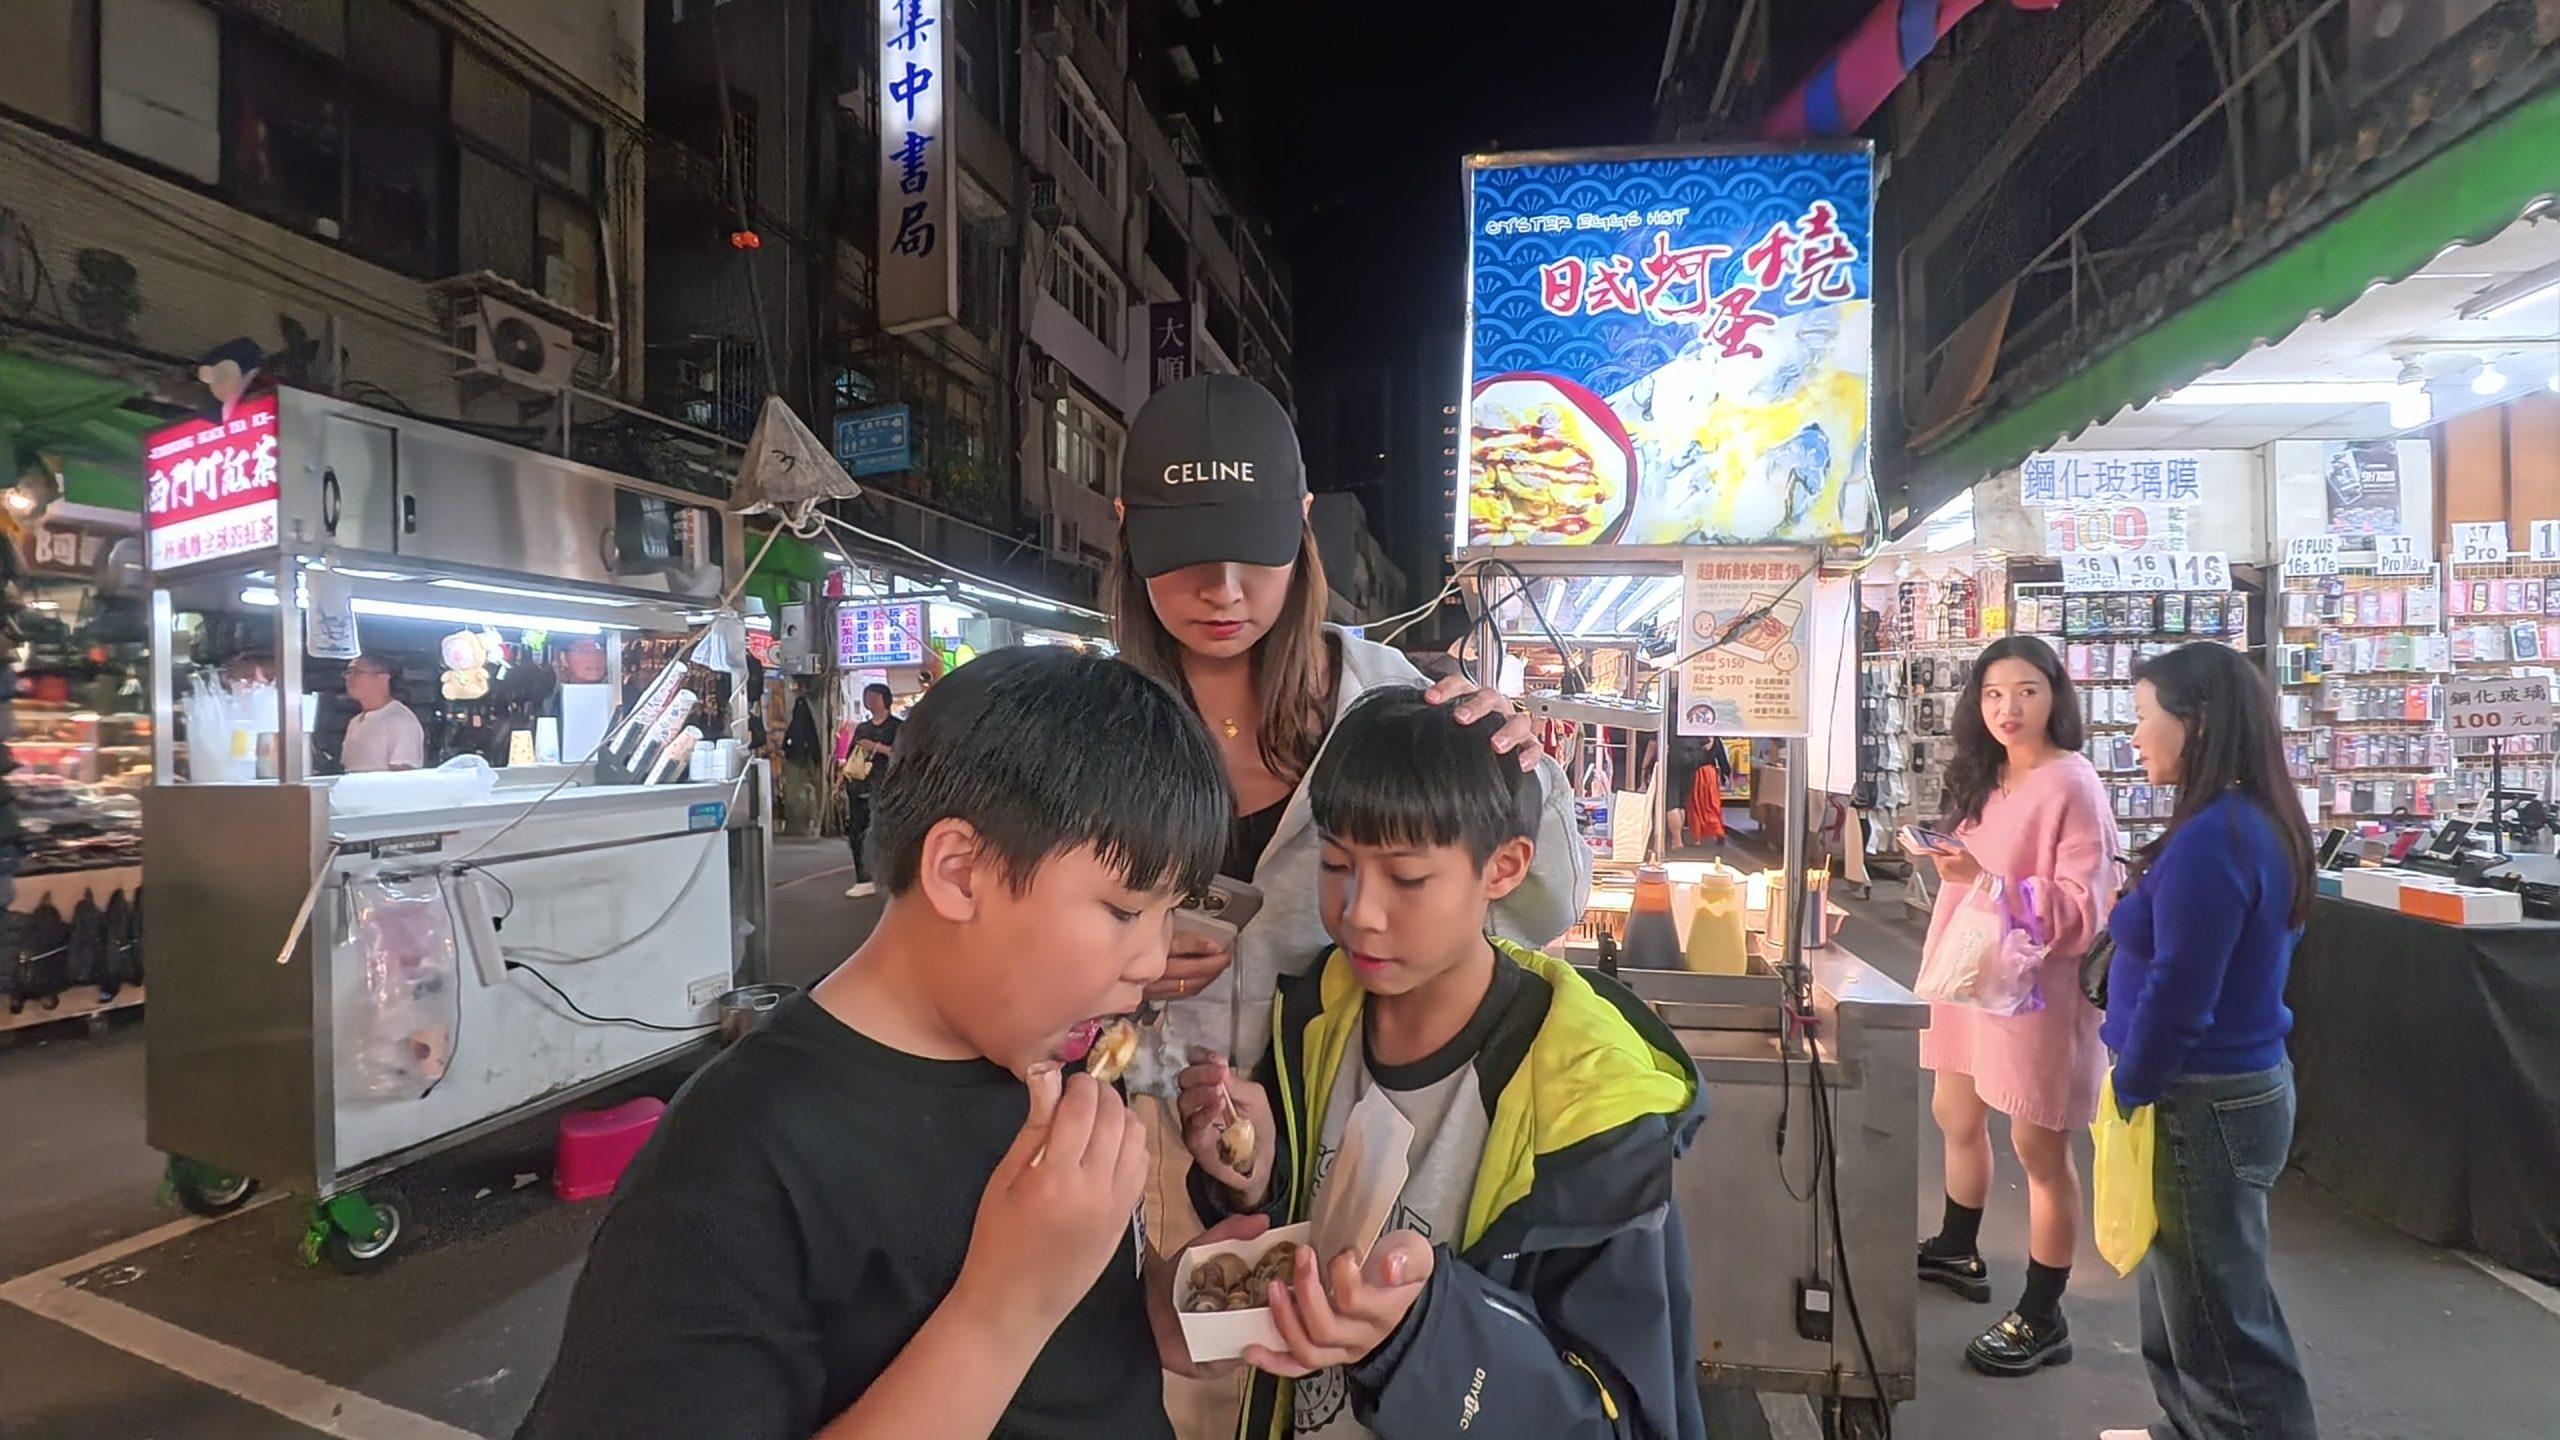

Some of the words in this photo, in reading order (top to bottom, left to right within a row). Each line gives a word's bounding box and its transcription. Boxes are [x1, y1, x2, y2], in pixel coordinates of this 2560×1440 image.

[887, 0, 935, 257] 集中書局
[1486, 216, 1572, 234] OYSTER
[1647, 207, 1690, 225] HOT
[149, 434, 277, 513] 西門町紅茶
[1164, 461, 1255, 485] CELINE
[2024, 458, 2199, 500] 鋼化玻璃膜
[2051, 506, 2148, 551] 100
[2291, 539, 2304, 554] 16
[2306, 538, 2333, 554] PLUS
[2391, 538, 2411, 554] 17
[2540, 522, 2560, 558] 1
[2133, 555, 2157, 571] 16
[2465, 546, 2498, 561] Pro
[2078, 557, 2101, 572] 16
[2288, 558, 2310, 573] 16e
[2313, 557, 2336, 573] 17e
[2382, 556, 2400, 571] Pro
[2450, 684, 2546, 706] 鋼化玻璃
[2453, 712, 2502, 729] 100
